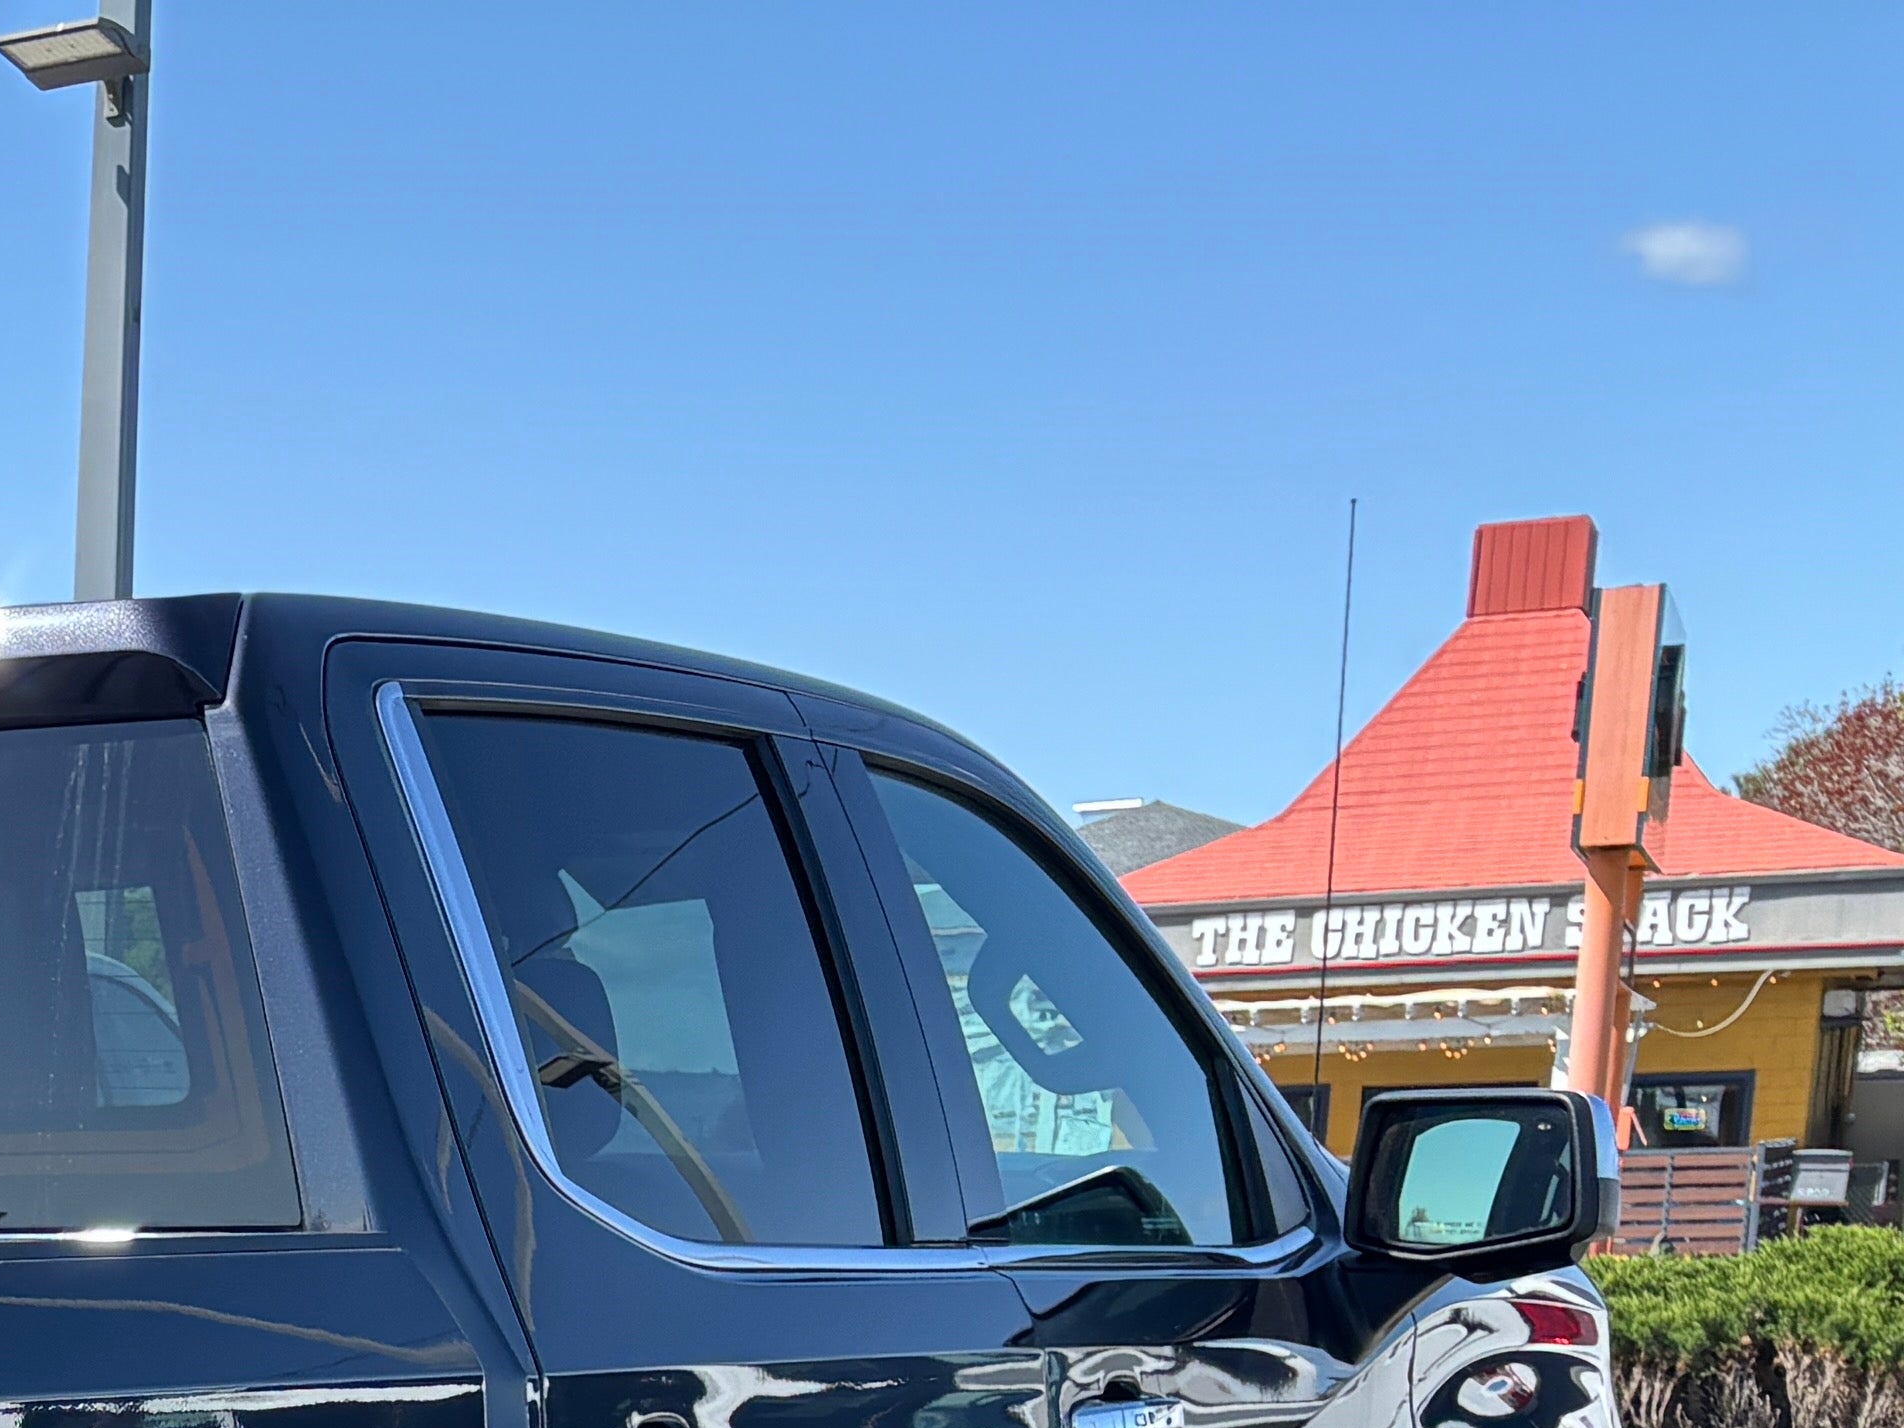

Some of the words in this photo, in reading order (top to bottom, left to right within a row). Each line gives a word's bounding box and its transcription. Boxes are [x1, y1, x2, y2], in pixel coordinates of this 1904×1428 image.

[1193, 910, 1296, 967] THE
[1309, 897, 1550, 961] CHICKEN
[1565, 886, 1752, 949] SACK
